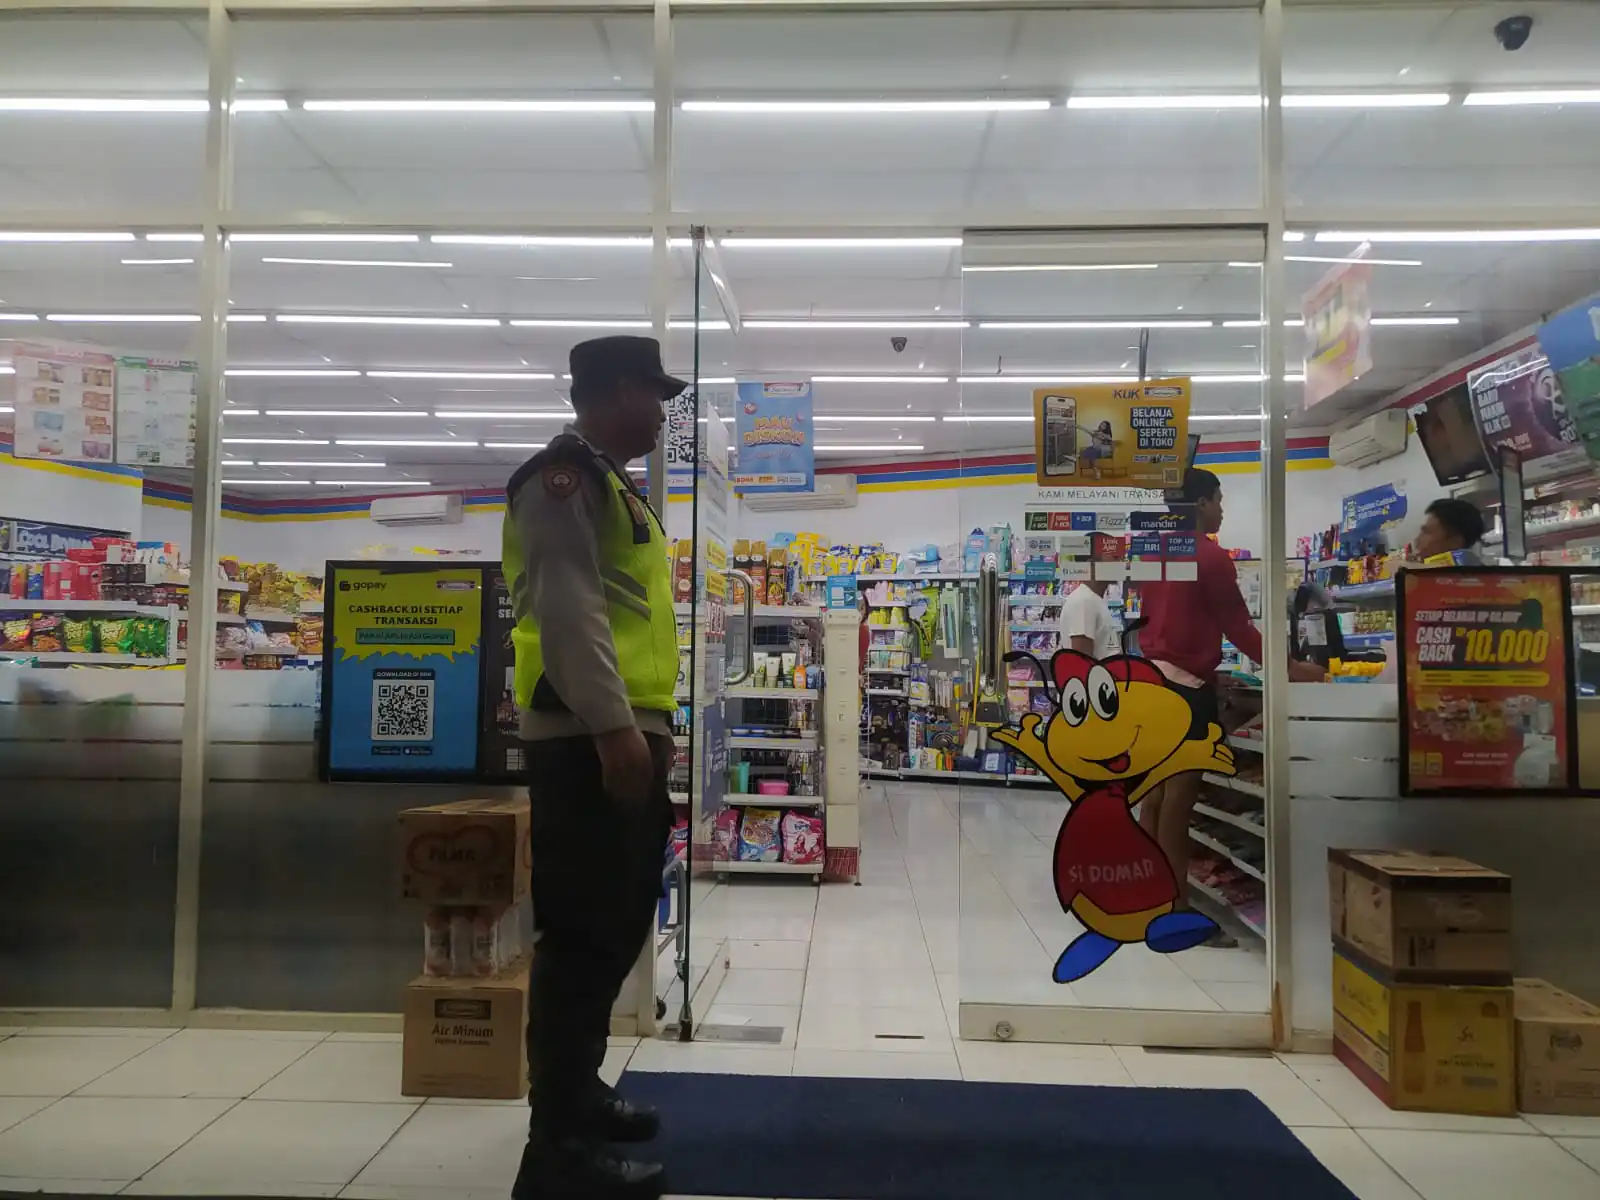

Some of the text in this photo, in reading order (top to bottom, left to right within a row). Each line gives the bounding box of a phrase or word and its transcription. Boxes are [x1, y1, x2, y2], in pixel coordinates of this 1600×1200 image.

[1132, 408, 1173, 418] BELANJA
[1132, 418, 1165, 427] ONLINE
[1139, 428, 1176, 437] SEPERTI
[1139, 438, 1174, 447] DI TOKO
[1038, 490, 1064, 499] KAMI
[1067, 490, 1120, 499] MELAYANI
[1144, 543, 1160, 552] BRI
[353, 581, 387, 592] gopay
[348, 604, 463, 614] CASHBACK DI SETIAP
[374, 616, 438, 626] TRANSAKSI
[1415, 626, 1452, 644] CASH
[1418, 644, 1455, 662] BACK
[452, 1024, 494, 1037] Minum
